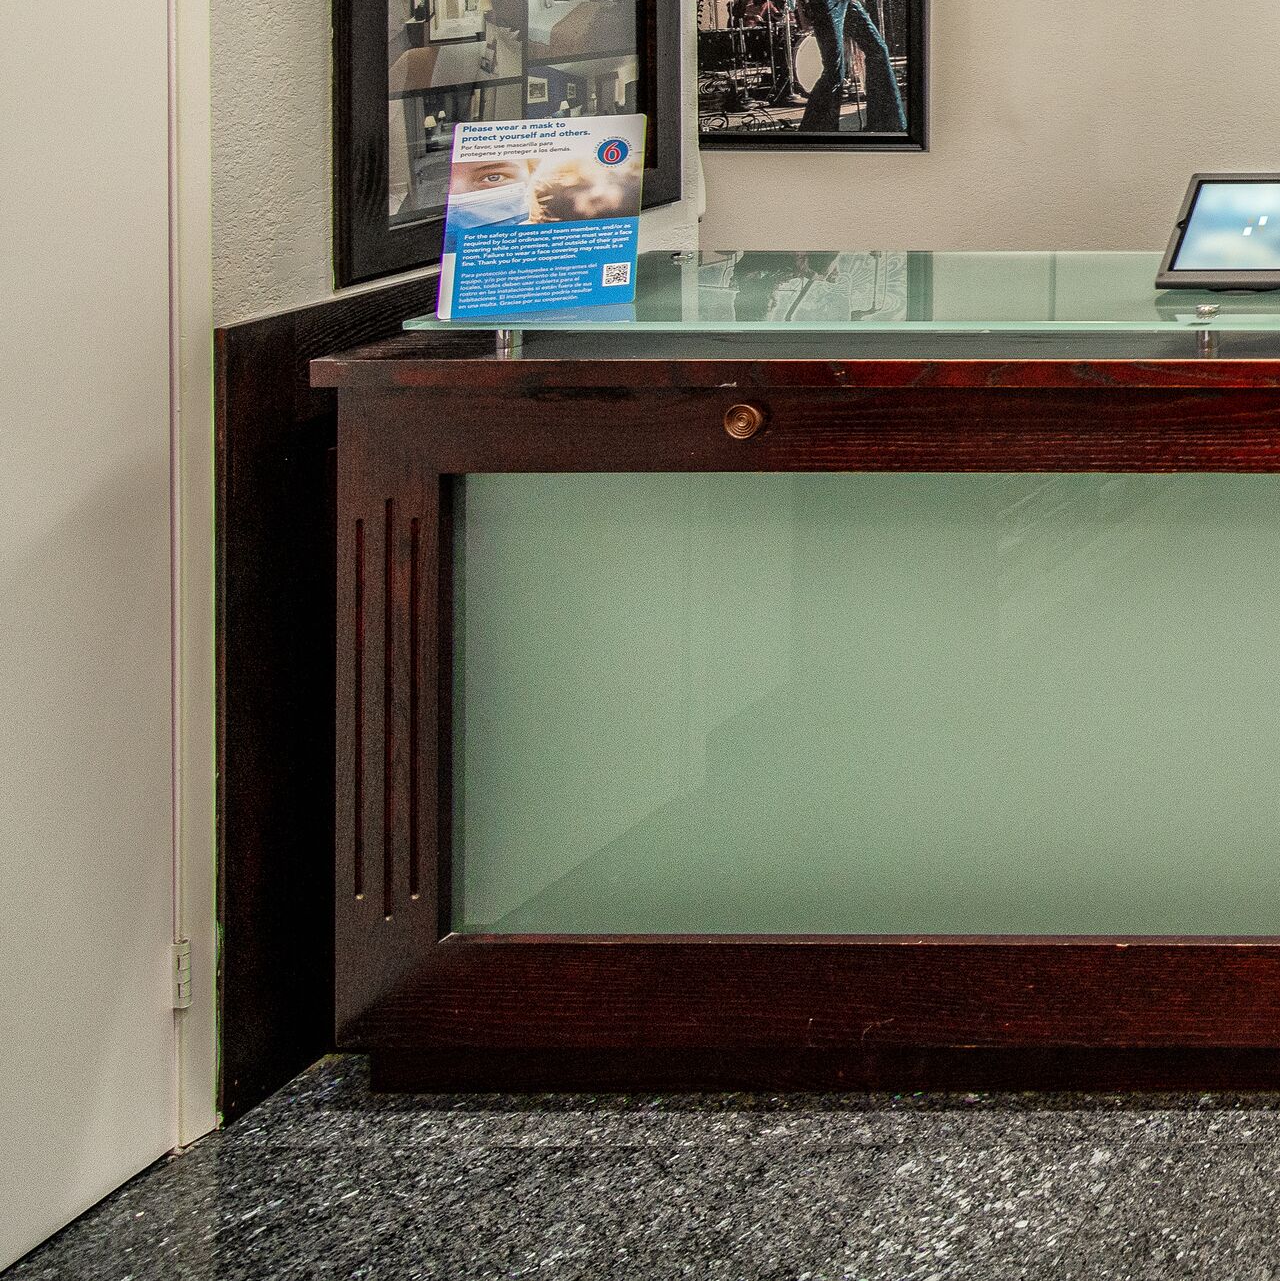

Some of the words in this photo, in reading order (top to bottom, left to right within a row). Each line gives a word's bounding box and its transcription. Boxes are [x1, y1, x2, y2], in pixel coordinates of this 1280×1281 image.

[462, 133, 497, 143] protect
[499, 132, 536, 142] yourself
[603, 142, 621, 163] 6
